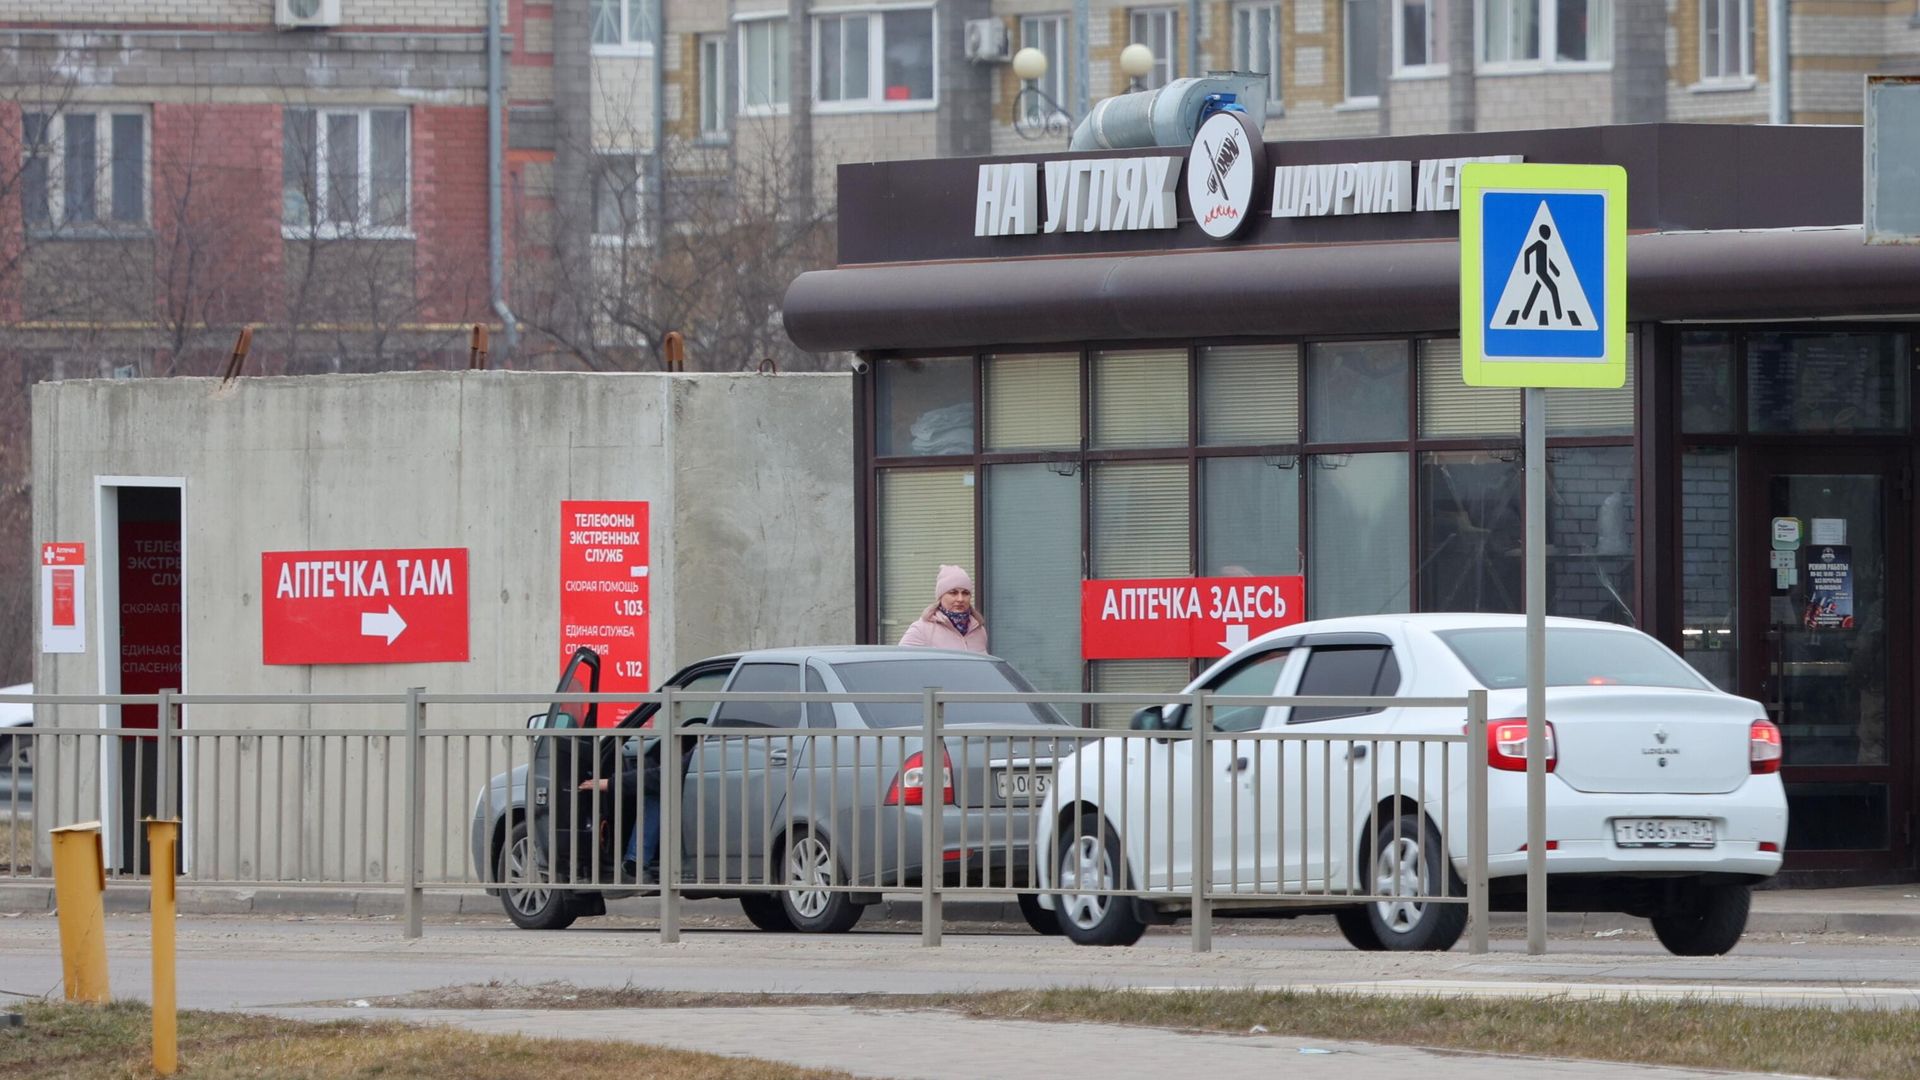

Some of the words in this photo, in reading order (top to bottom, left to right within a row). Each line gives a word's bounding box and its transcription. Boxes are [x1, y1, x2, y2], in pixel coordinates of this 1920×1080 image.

[975, 163, 1037, 236] НА
[1044, 157, 1183, 233] УГЛЯХ
[1271, 161, 1411, 218] ШАУРМА
[575, 513, 634, 528] ТЕЛЕФОНЫ
[569, 531, 640, 545] ЭКСТРЕННЫХ
[585, 548, 624, 563] СЛУЖБ
[276, 561, 390, 599] АПТЕЧКА
[397, 558, 454, 597] ТАМ
[565, 580, 597, 592] СКОРАЯ
[598, 581, 639, 594] ПОМОЩЬ
[122, 603, 168, 614] СКОРАЯ
[623, 600, 644, 616] 103
[1101, 586, 1203, 620] АПТЕЧКА
[1209, 585, 1286, 623] ЗДЕСЬ
[566, 625, 598, 638] ЕДИНАЯ
[599, 625, 635, 637] СЛУЖБА
[122, 644, 170, 657] ЕДИНАЯ
[626, 661, 643, 677] 112
